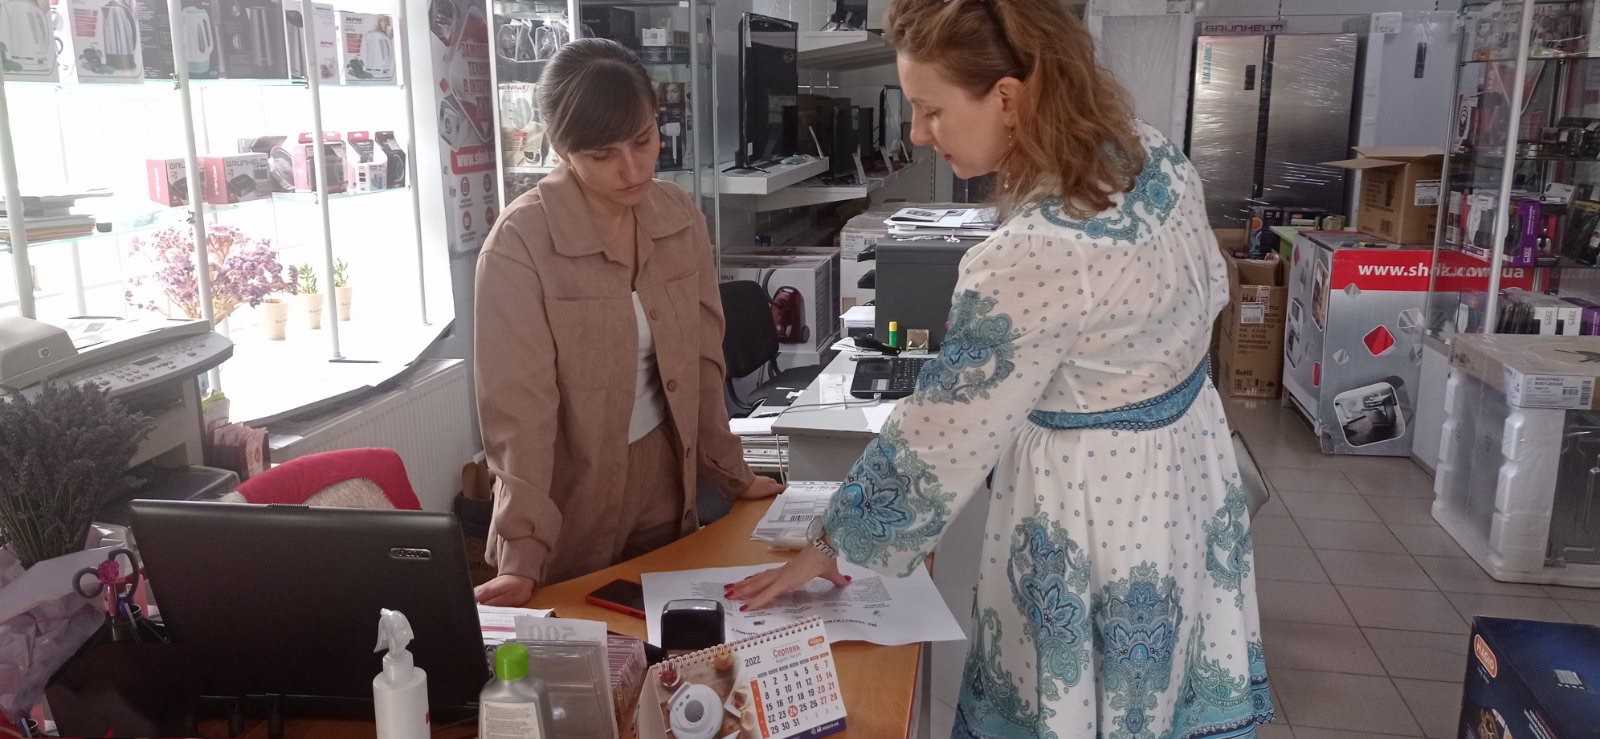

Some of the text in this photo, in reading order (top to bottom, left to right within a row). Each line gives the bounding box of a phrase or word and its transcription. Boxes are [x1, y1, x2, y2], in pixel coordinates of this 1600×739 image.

[1358, 260, 1525, 279] www.shk.comua
[745, 656, 761, 667] 2022
[763, 680, 766, 688] 1
[773, 677, 777, 685] 2
[785, 685, 792, 693] 10
[766, 703, 773, 711] 15
[768, 715, 775, 723] 22
[779, 711, 786, 719] 23
[771, 726, 779, 734] 29
